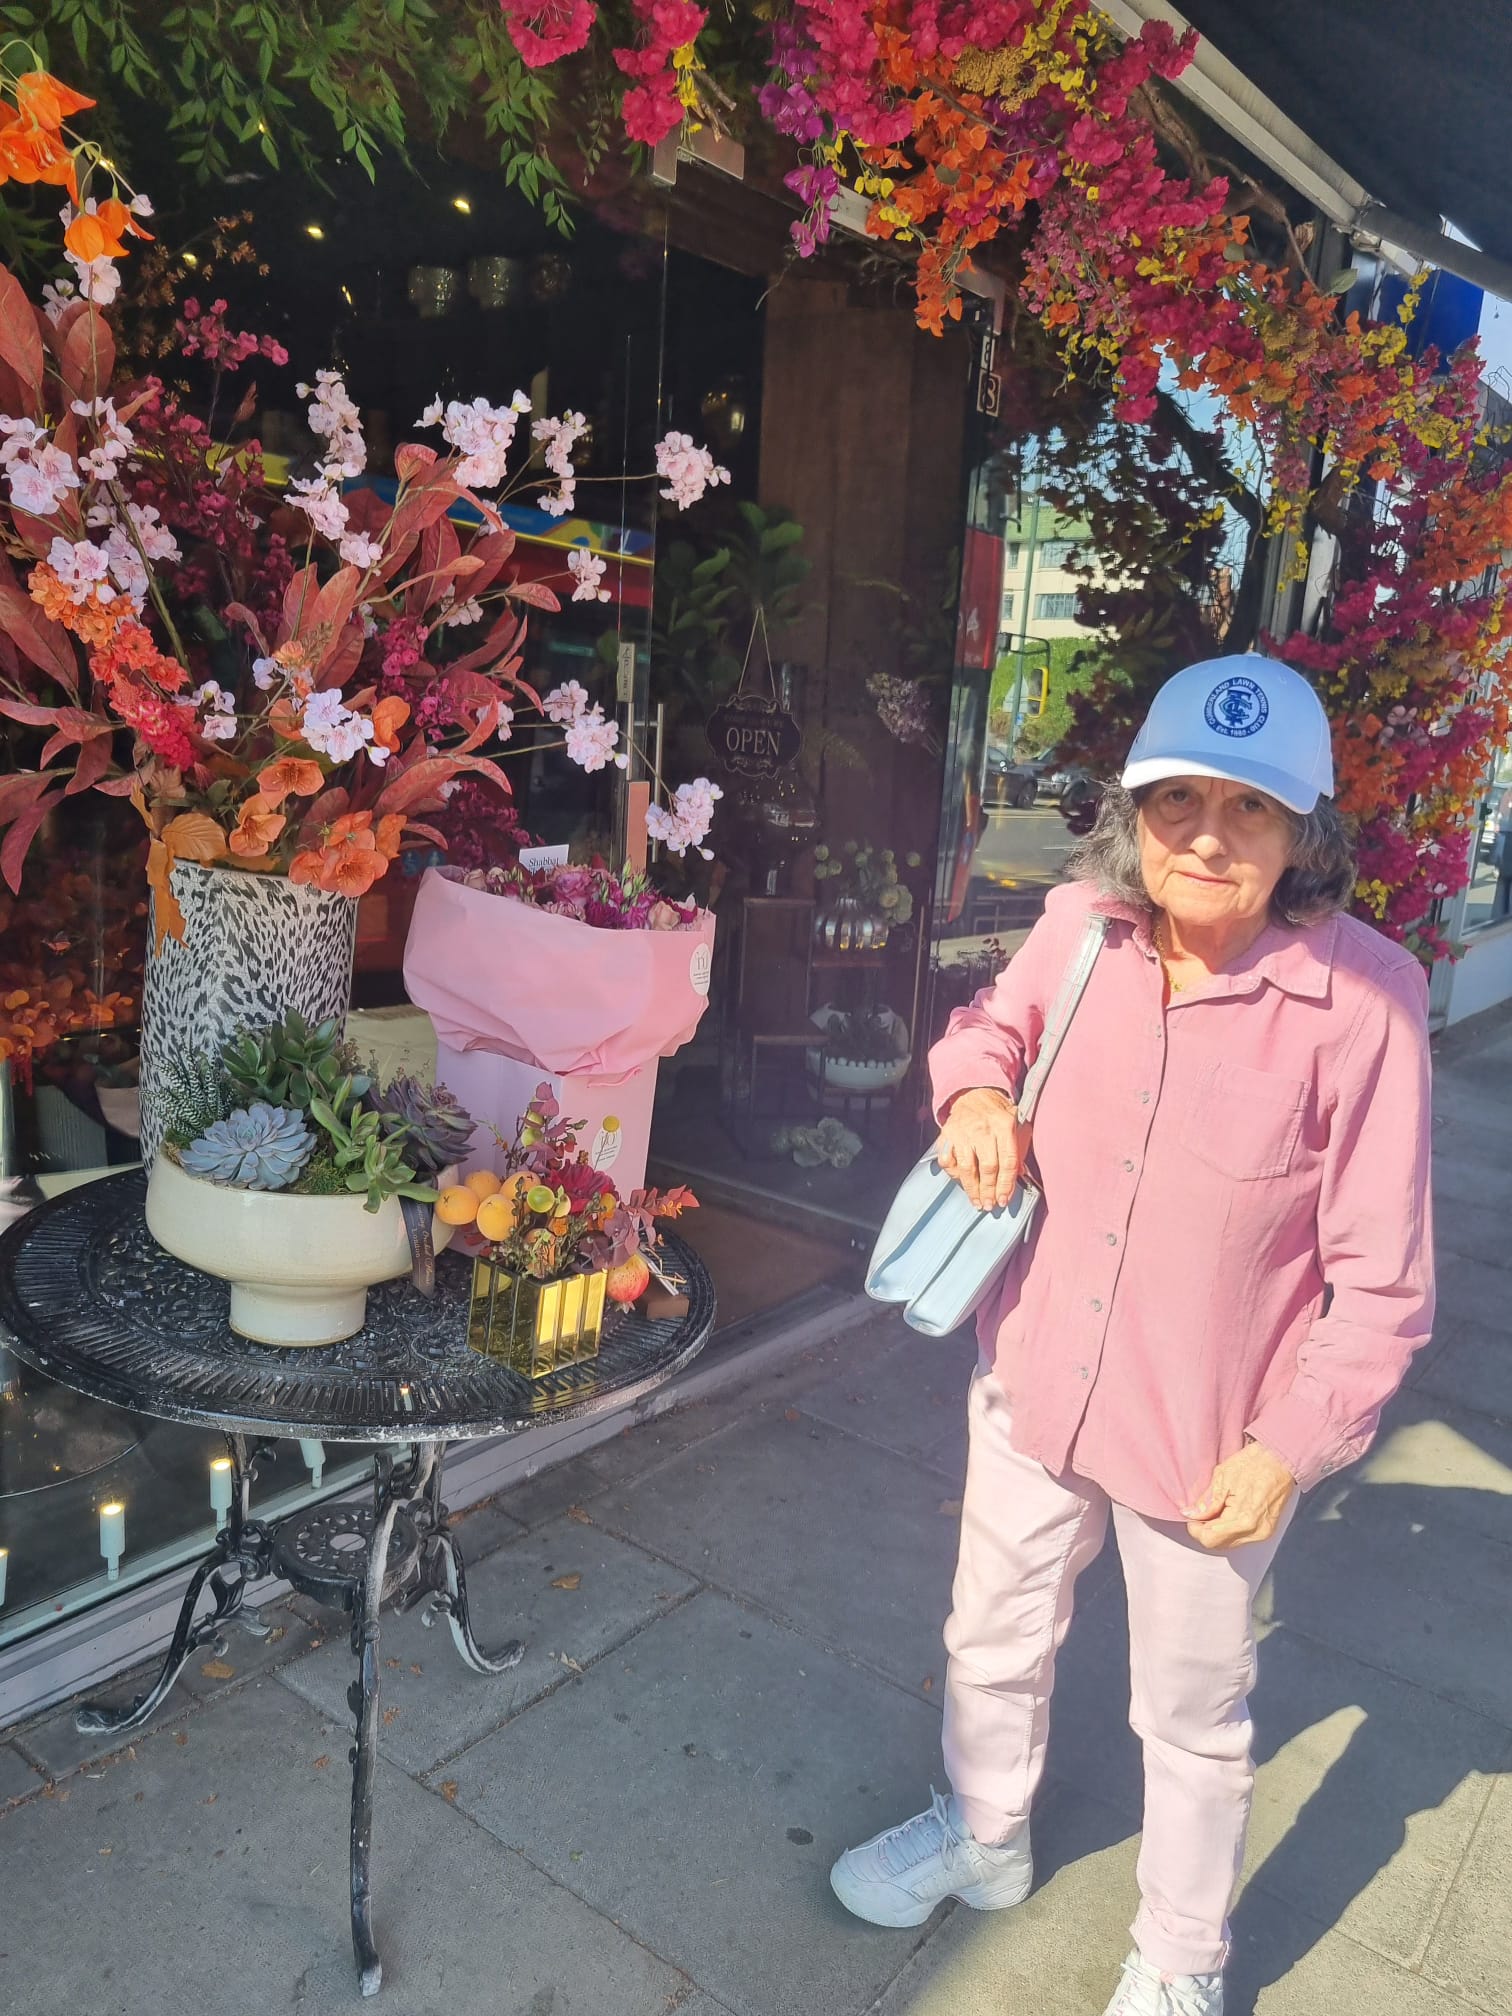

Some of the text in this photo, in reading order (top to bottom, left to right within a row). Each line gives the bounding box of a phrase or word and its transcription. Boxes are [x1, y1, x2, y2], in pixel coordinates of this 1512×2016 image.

[1232, 679, 1255, 689] LAWN
[1249, 715, 1266, 733] CLUB
[726, 727, 781, 756] OPEN
[529, 856, 559, 867] Shabbat
